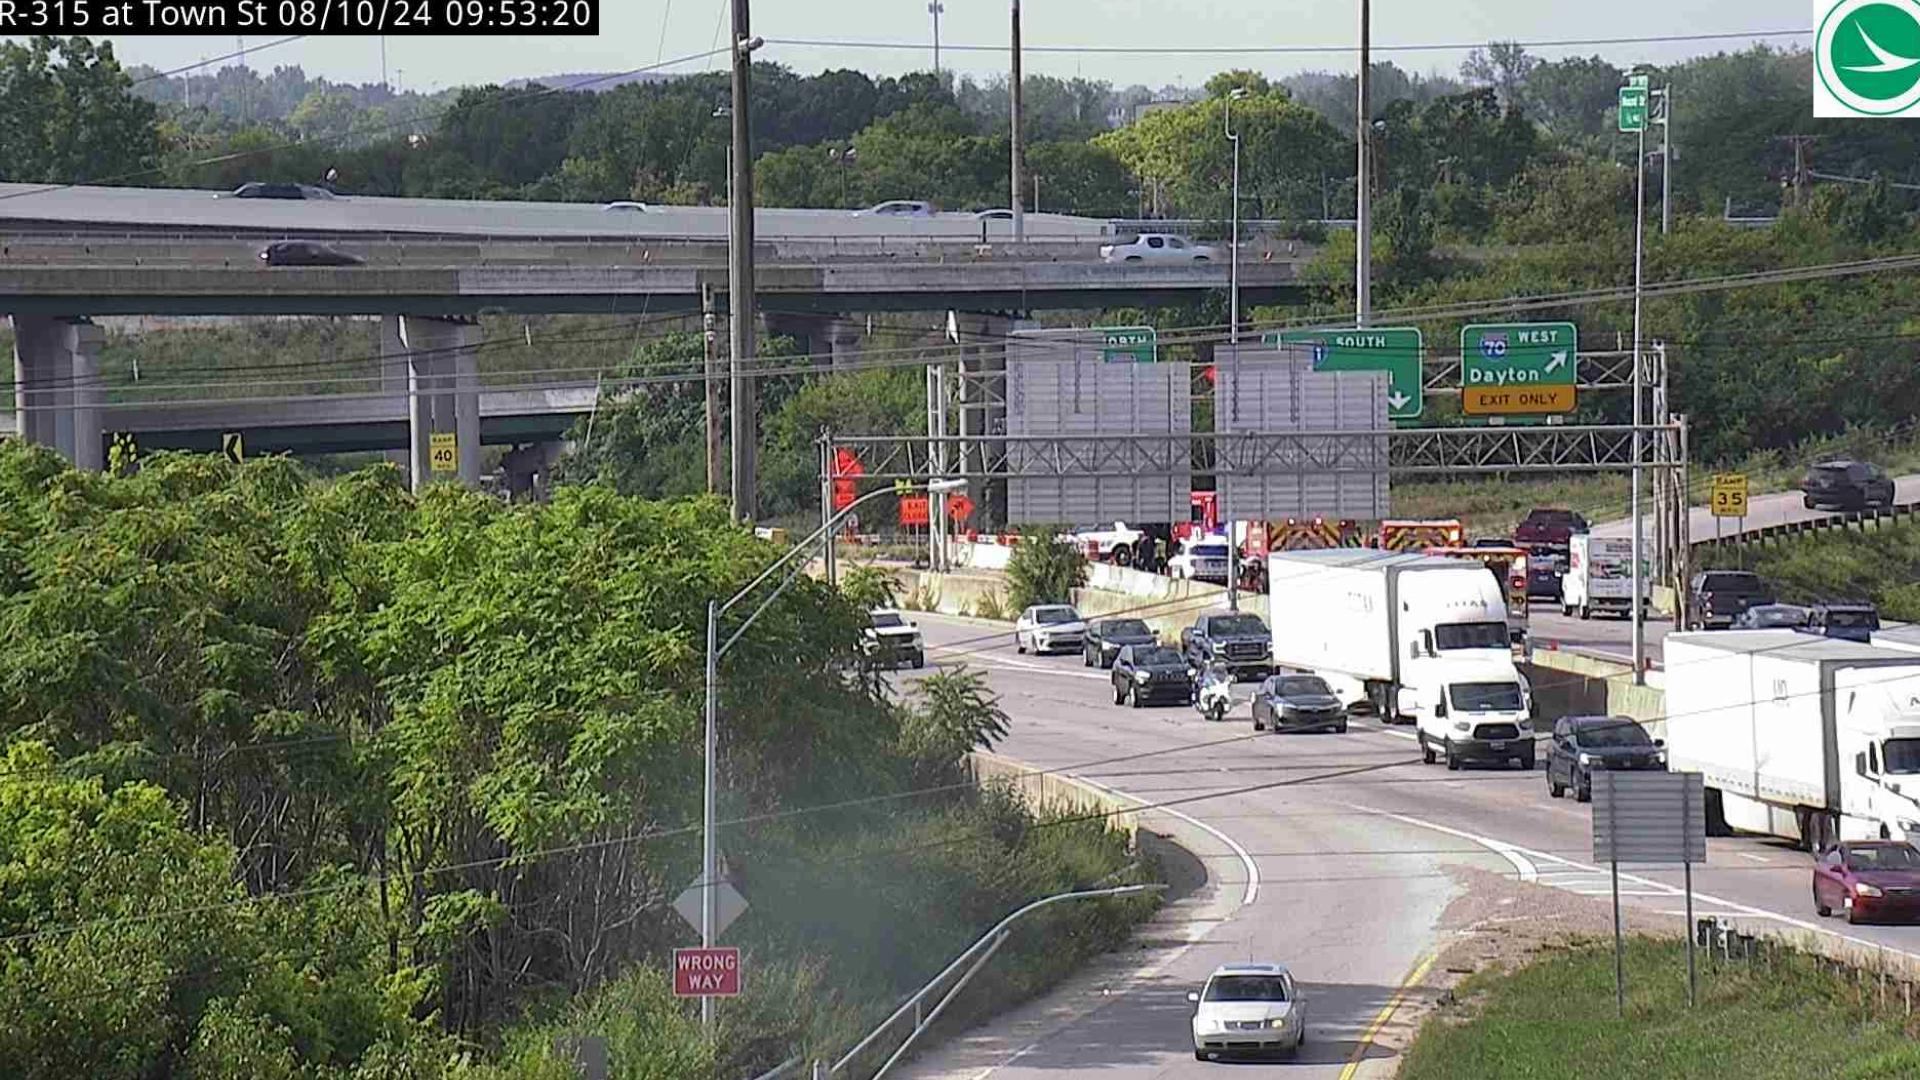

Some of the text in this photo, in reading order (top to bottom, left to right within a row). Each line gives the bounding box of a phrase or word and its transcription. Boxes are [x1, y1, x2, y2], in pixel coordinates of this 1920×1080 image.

[1103, 335, 1147, 346] ORTH
[1336, 336, 1385, 348] SOUTH
[1518, 330, 1558, 343] WEST
[1484, 341, 1506, 356] 70
[1470, 367, 1539, 386] Dayton
[1480, 393, 1558, 406] EXIT ONLY
[434, 449, 453, 462] 40
[1717, 492, 1743, 506] 35
[678, 954, 736, 971] WRONG
[688, 974, 724, 990] WAY
